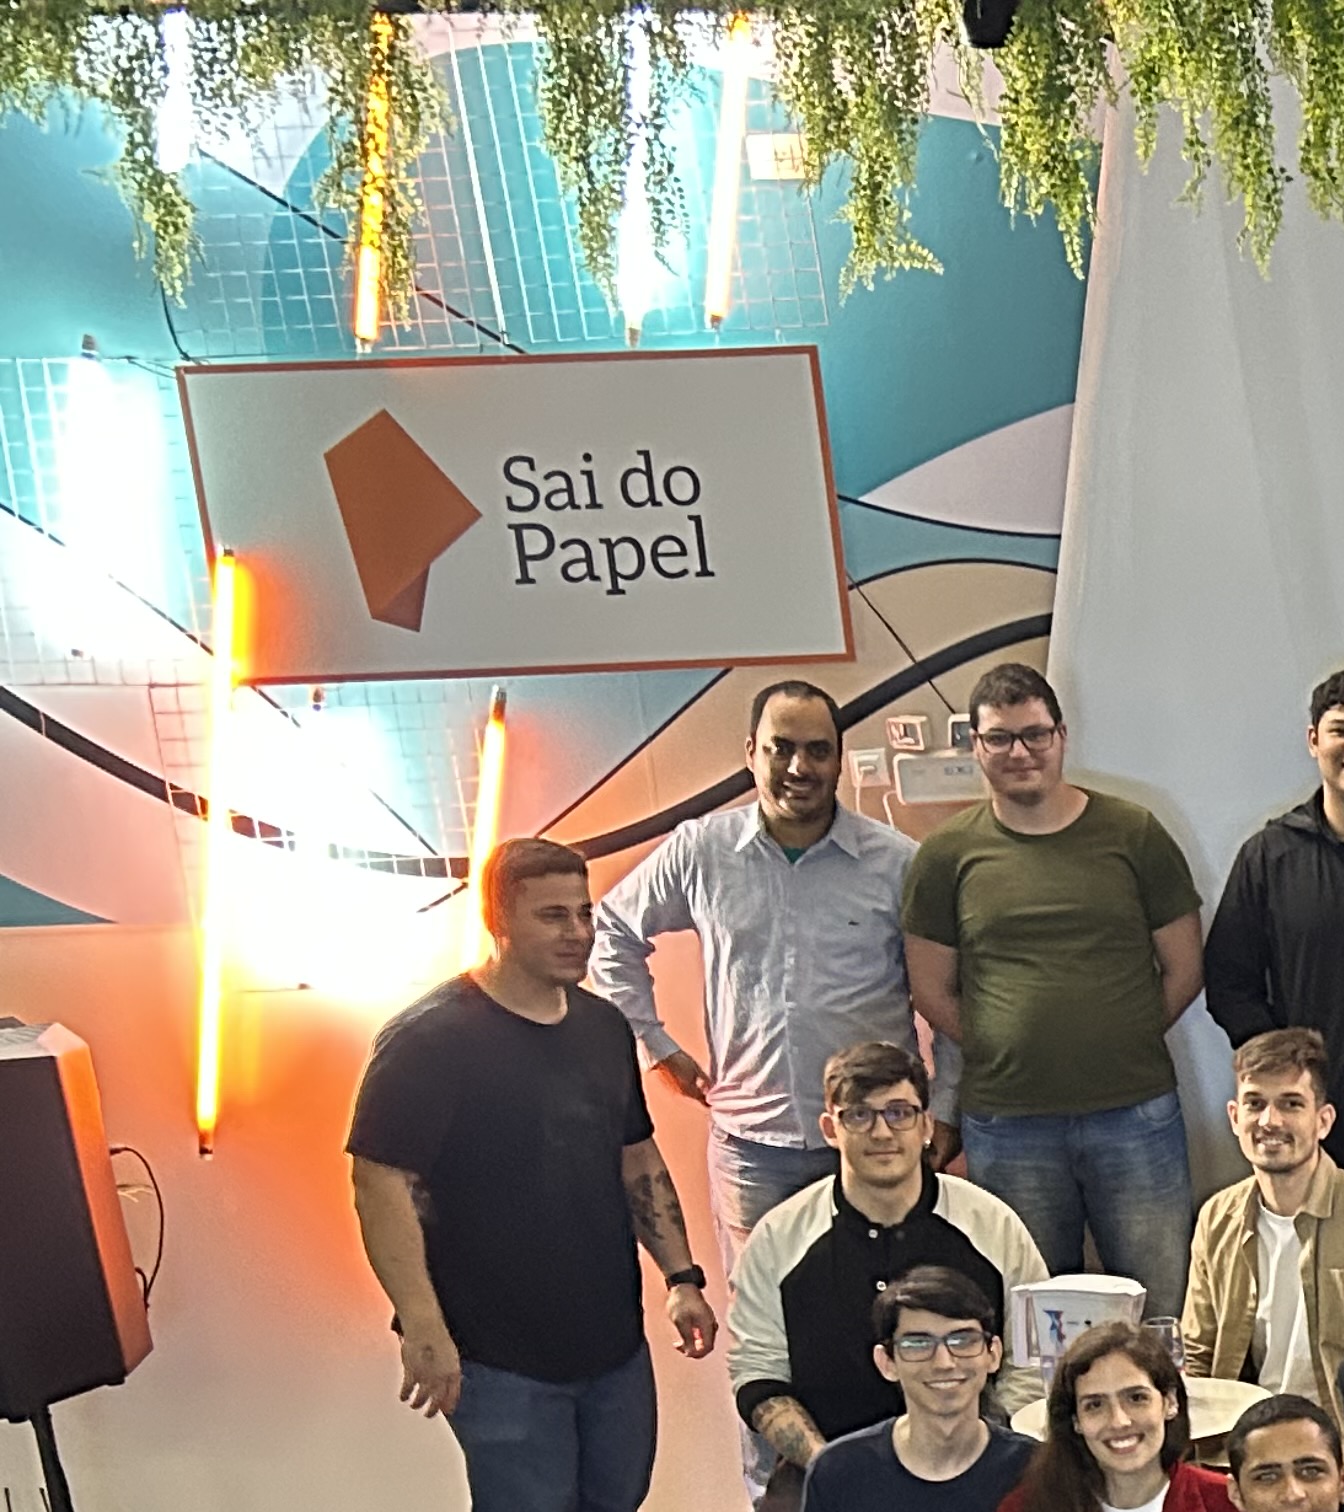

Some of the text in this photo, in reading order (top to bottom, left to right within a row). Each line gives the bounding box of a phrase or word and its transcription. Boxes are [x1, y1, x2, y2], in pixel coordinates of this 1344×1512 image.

[503, 449, 701, 513] Sai do
[507, 514, 716, 596] Papel
